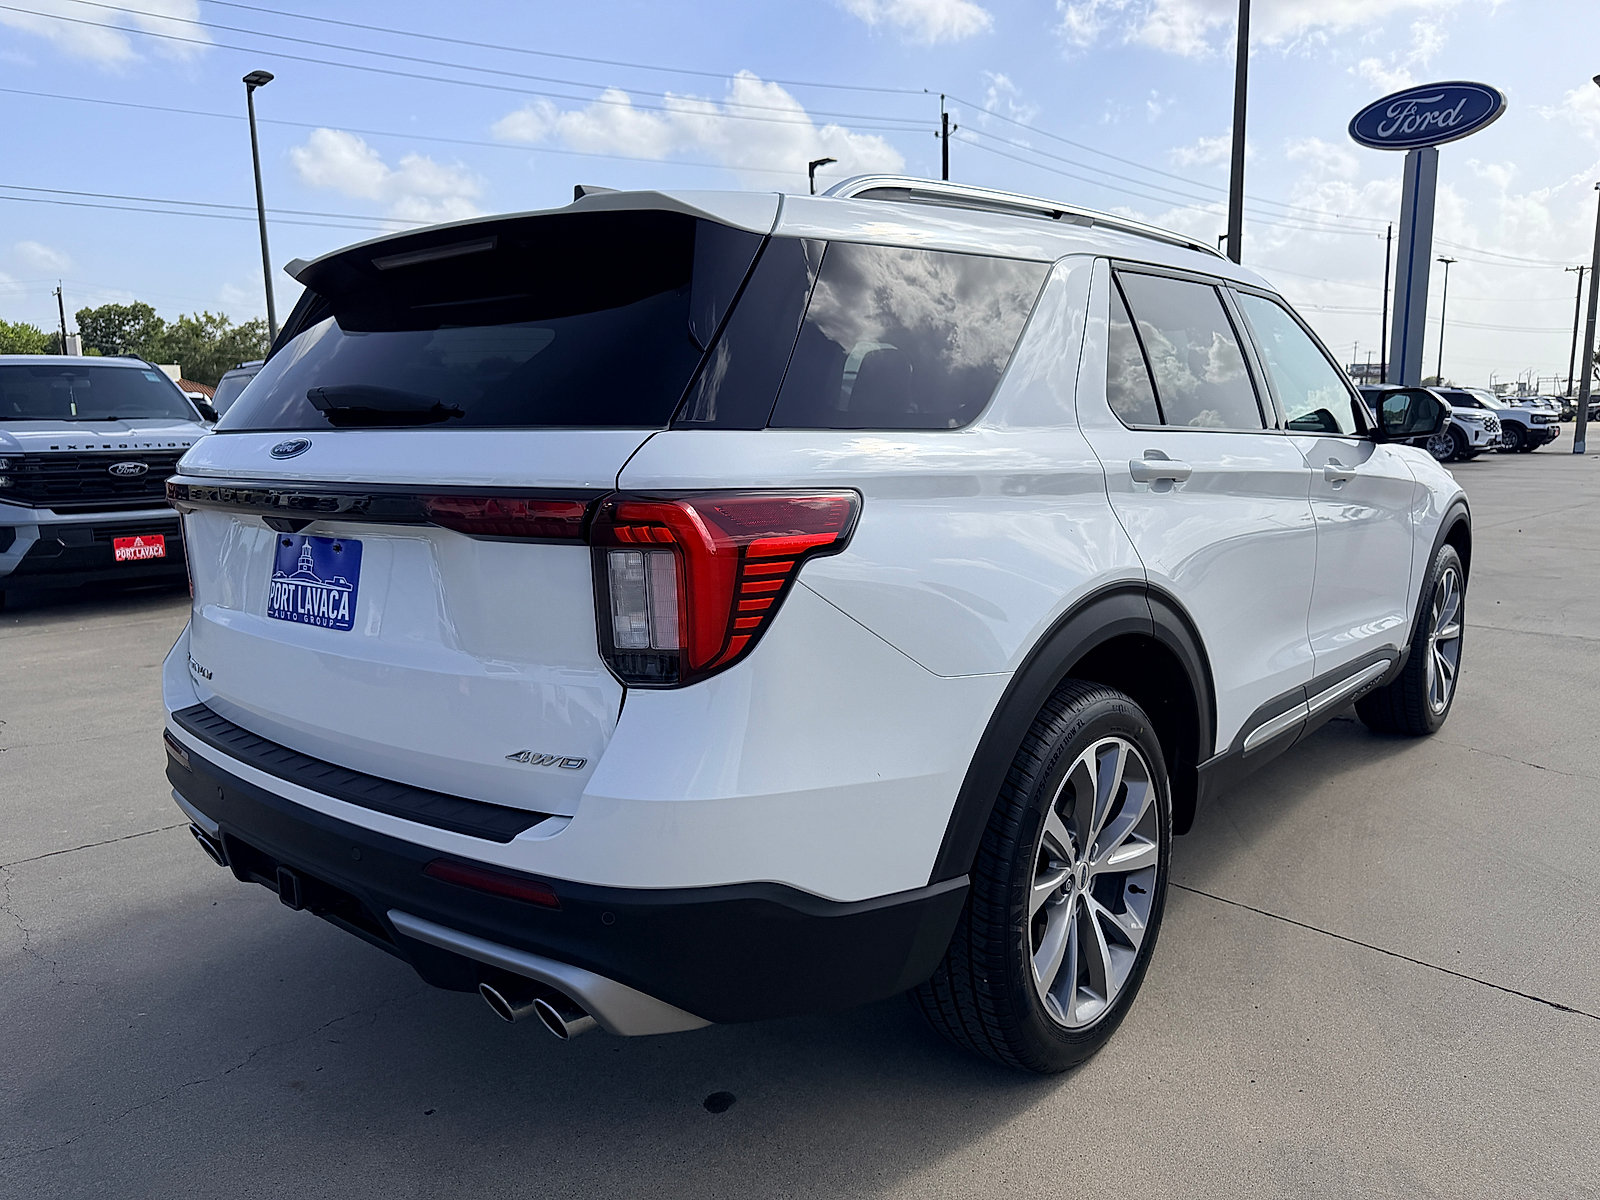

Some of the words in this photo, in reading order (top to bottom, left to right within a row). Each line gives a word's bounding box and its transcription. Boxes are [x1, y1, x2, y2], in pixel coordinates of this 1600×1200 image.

[1377, 94, 1468, 138] Ford
[50, 442, 191, 450] EXPEDITION
[116, 547, 135, 560] PORT
[136, 546, 163, 558] LAVACA
[268, 581, 296, 612] PORT
[297, 585, 350, 621] LAVACA
[274, 610, 298, 620] AUTO
[303, 615, 334, 628] GROUP
[504, 749, 588, 770] 4WD
